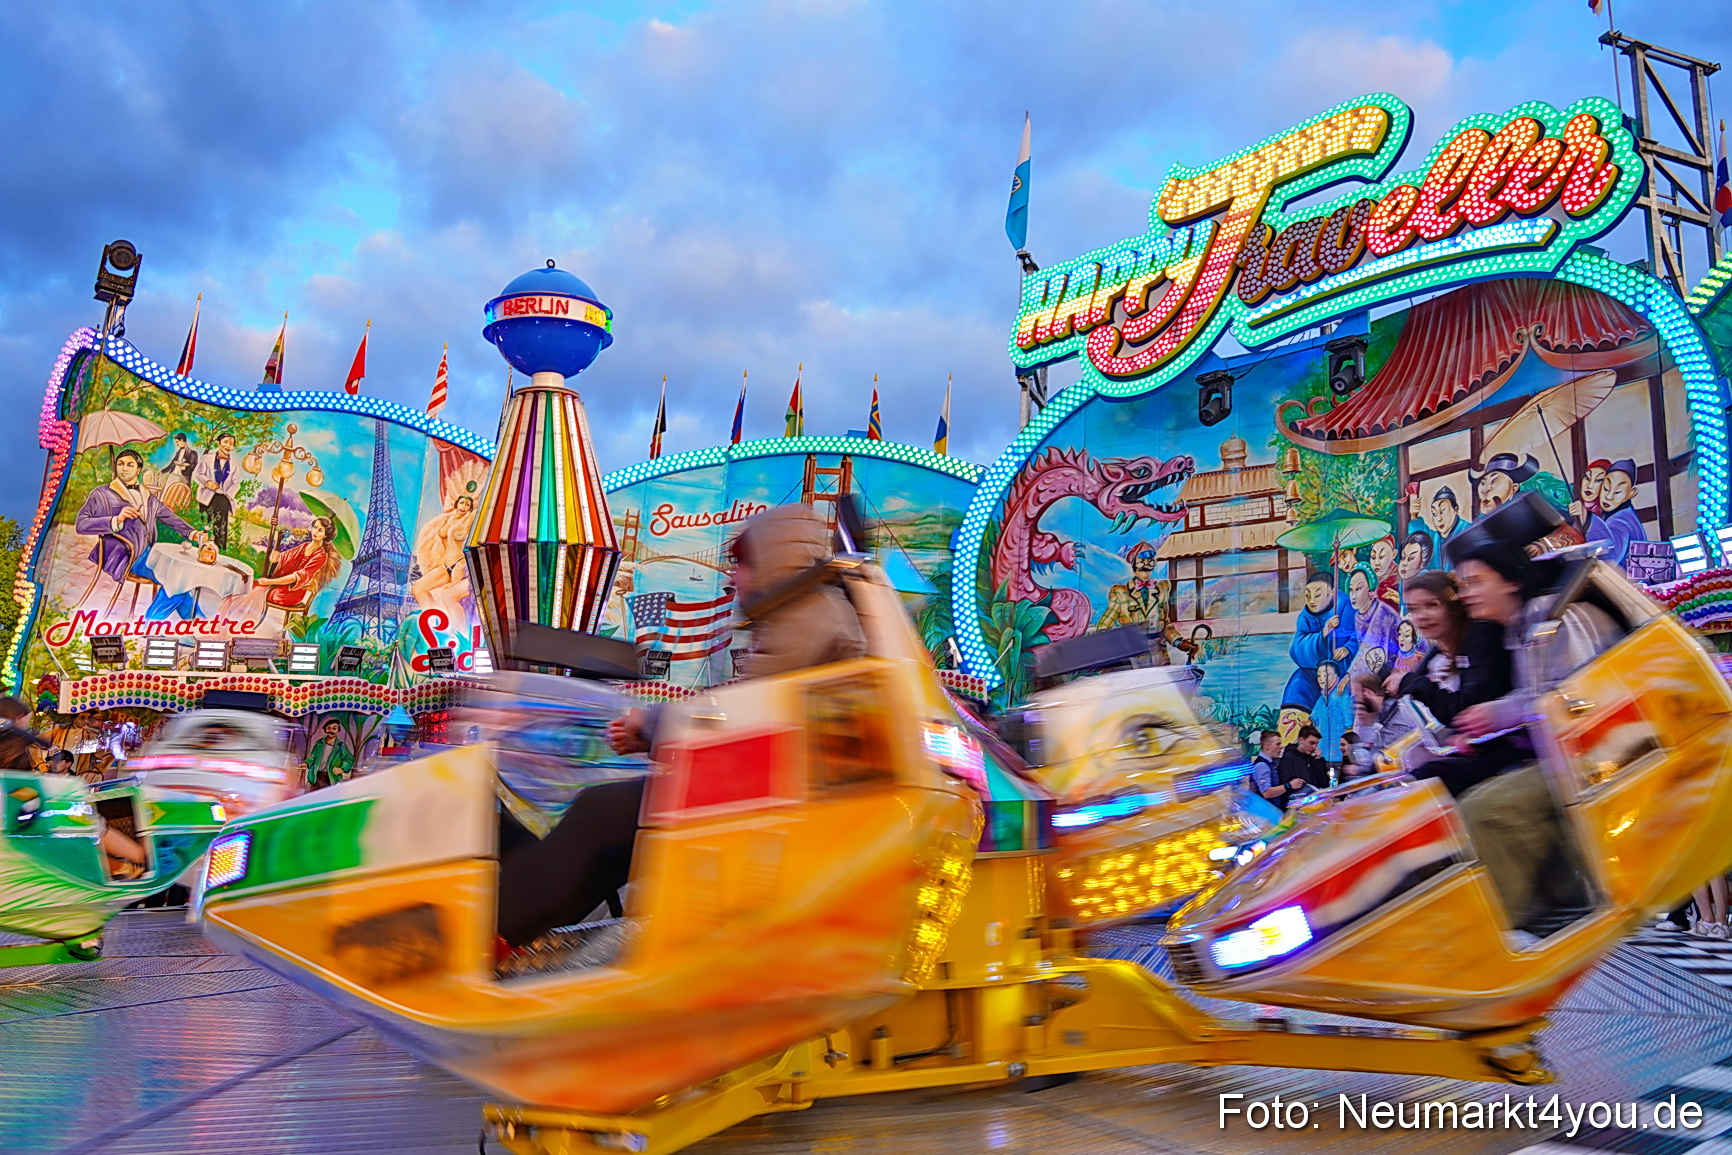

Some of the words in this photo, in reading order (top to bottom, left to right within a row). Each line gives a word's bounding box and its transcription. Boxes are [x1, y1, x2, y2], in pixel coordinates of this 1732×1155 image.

[1086, 104, 1618, 376] Traveller
[503, 297, 570, 316] BERLIN
[45, 609, 256, 647] Montmartre
